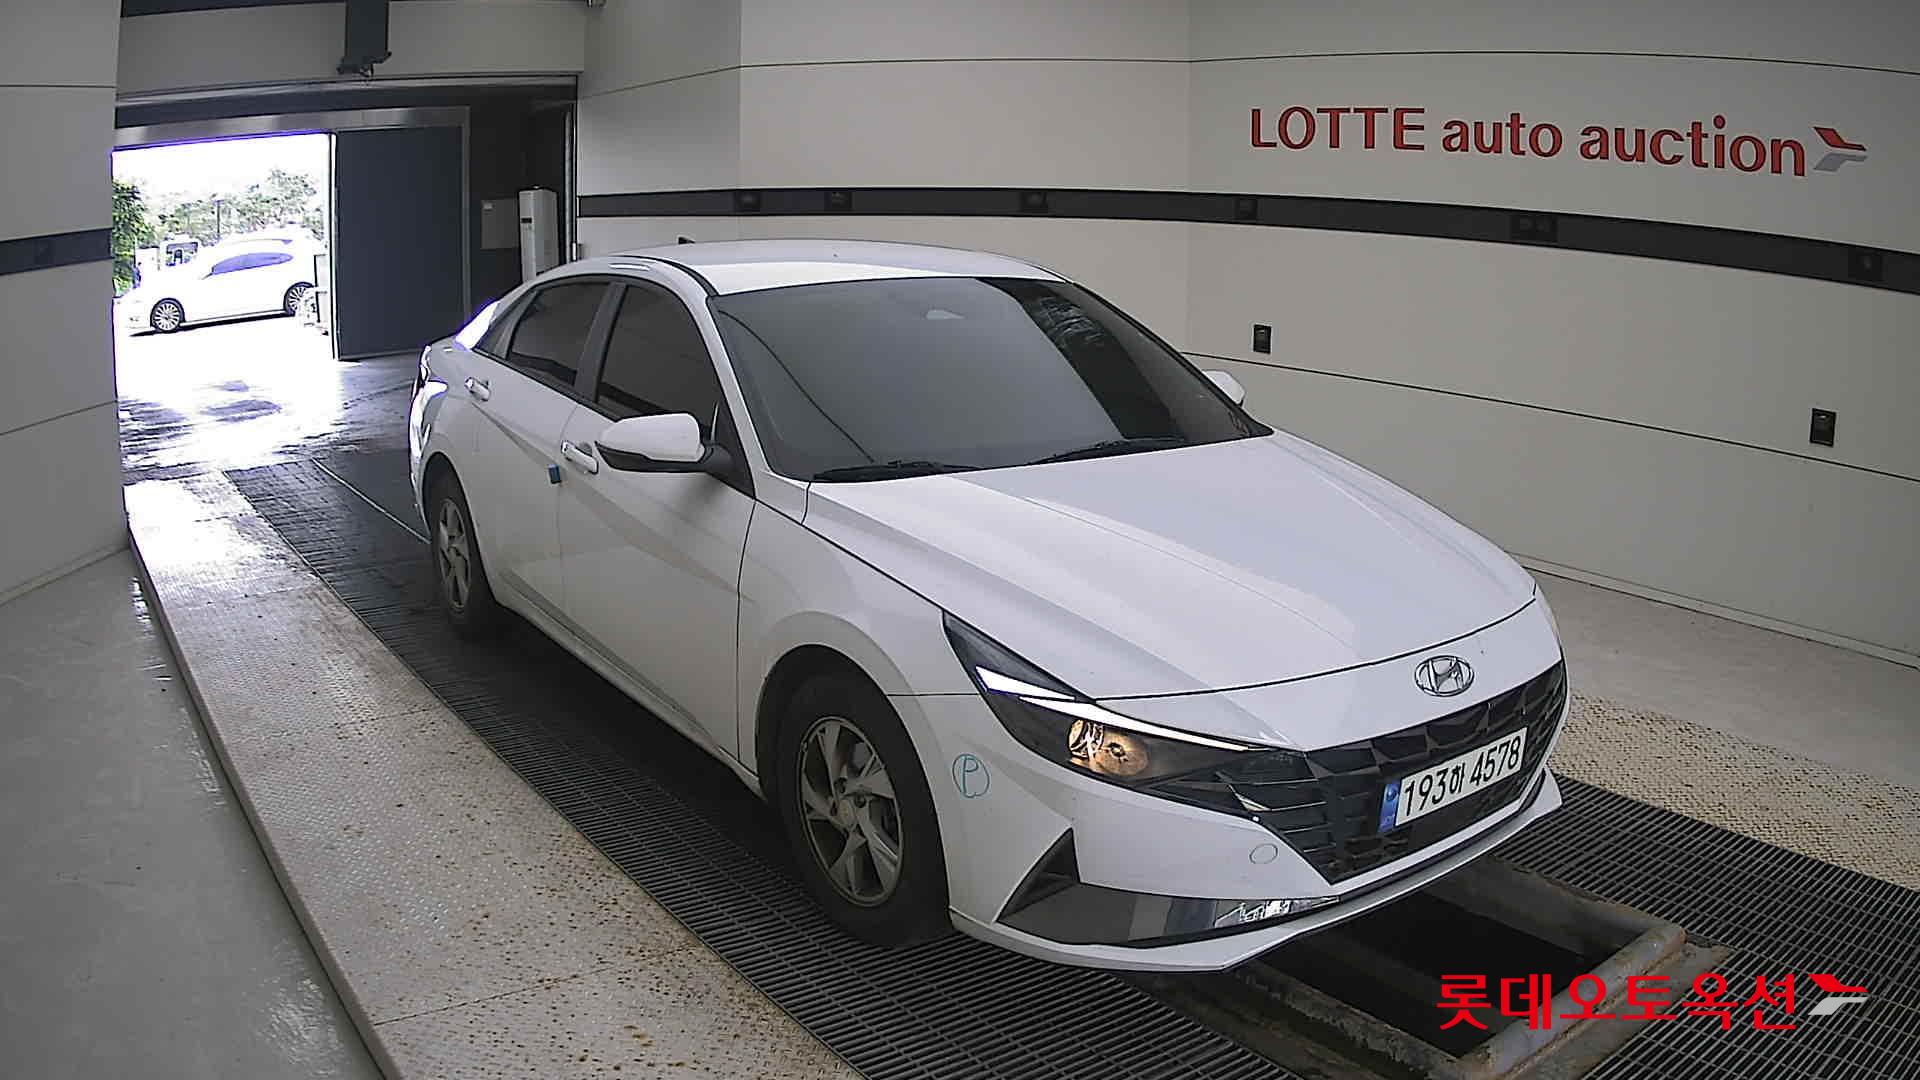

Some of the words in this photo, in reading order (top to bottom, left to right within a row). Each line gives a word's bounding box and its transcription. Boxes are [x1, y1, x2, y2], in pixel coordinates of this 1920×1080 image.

[1250, 106, 1426, 151] LOTTE
[1440, 112, 1565, 159] auto
[1578, 115, 1808, 178] auction
[1403, 761, 1467, 817] 193하
[1469, 734, 1522, 787] 4578
